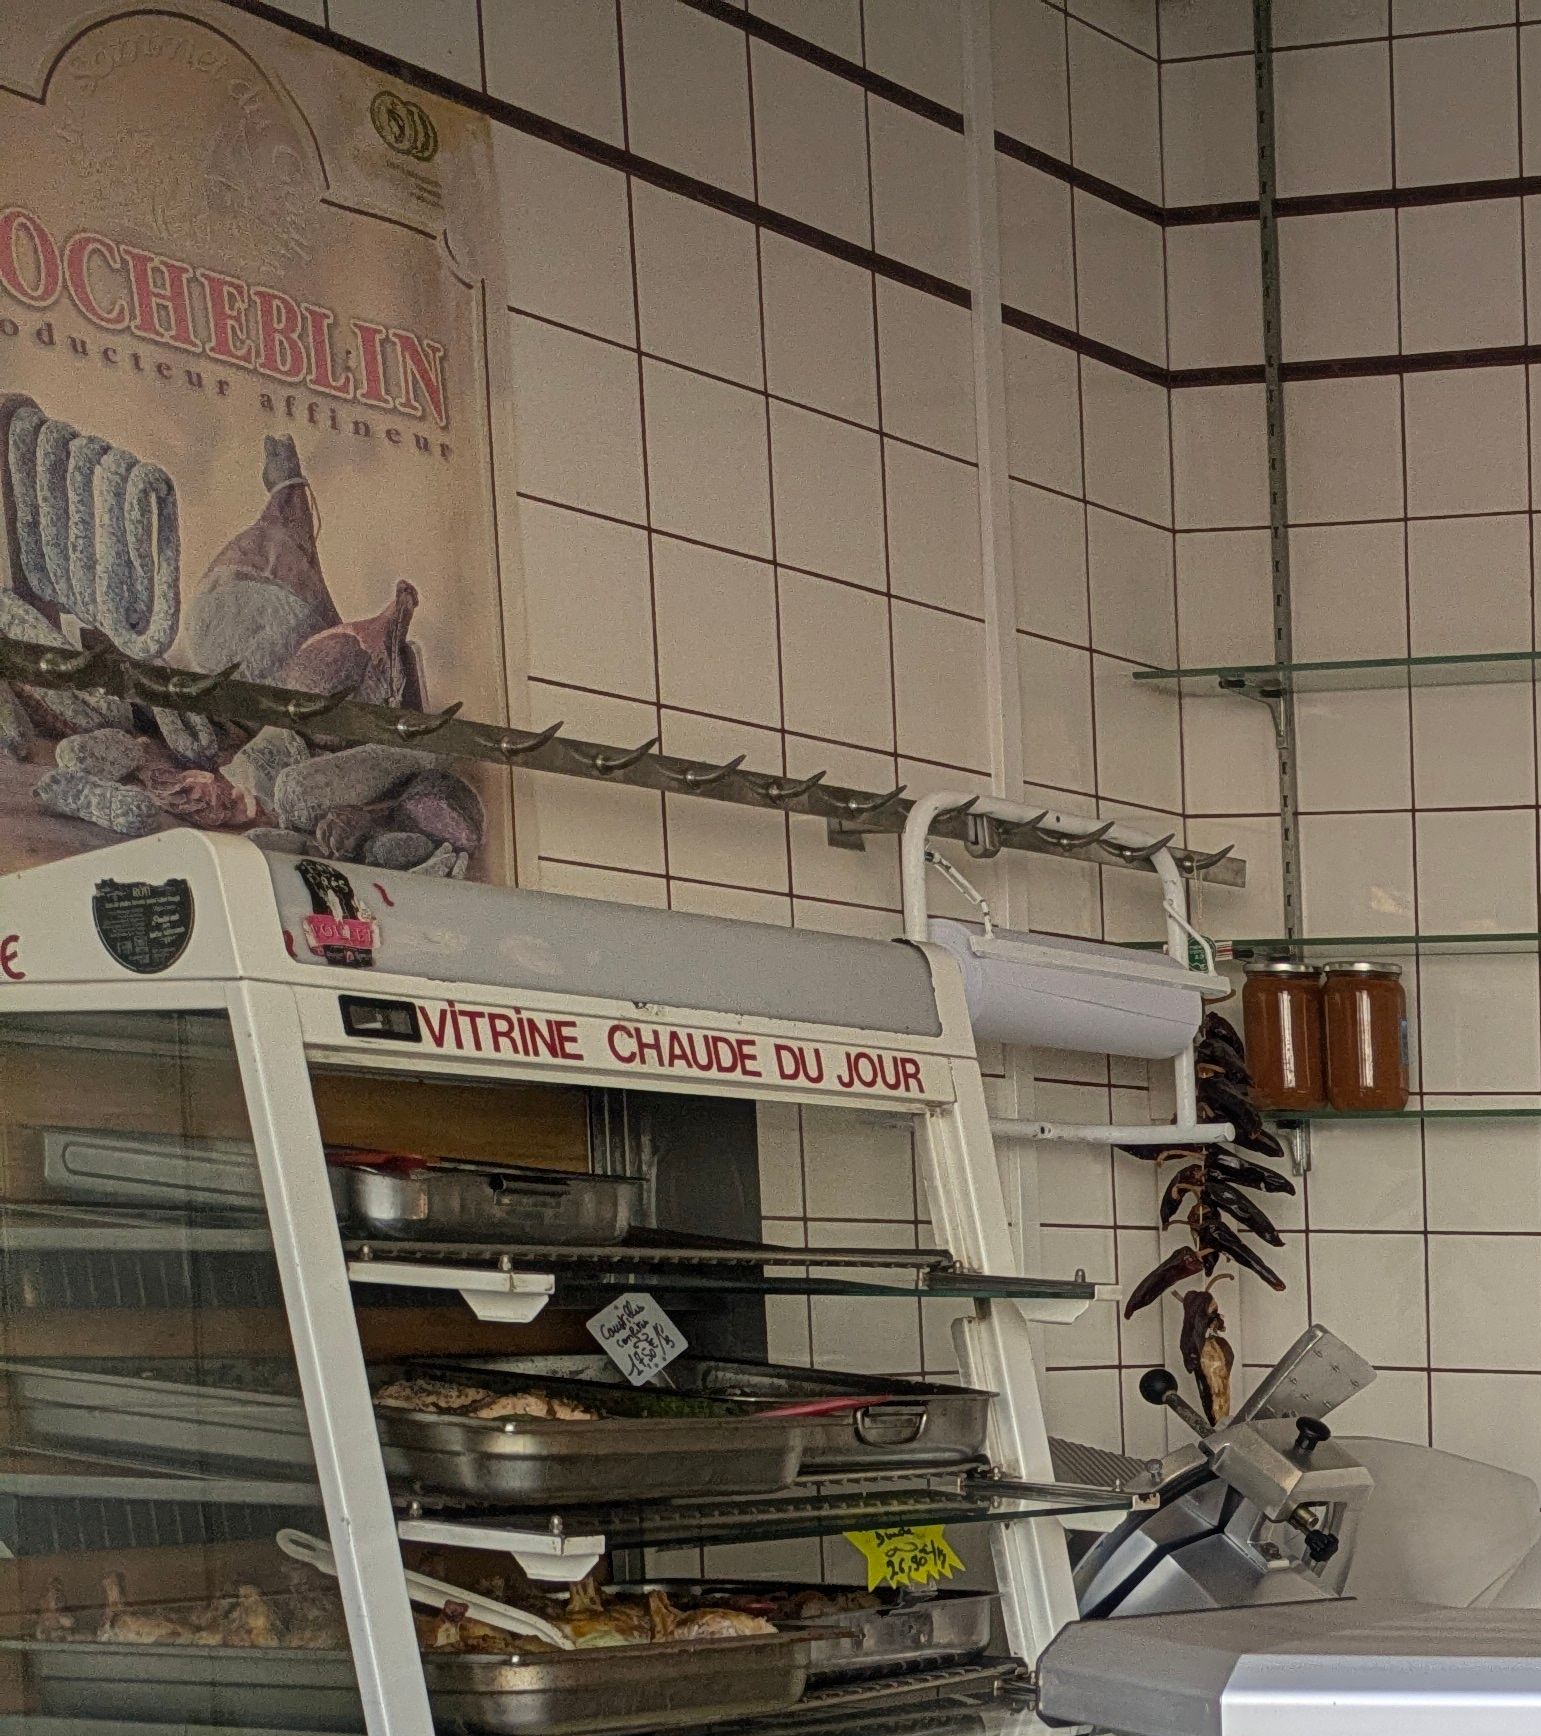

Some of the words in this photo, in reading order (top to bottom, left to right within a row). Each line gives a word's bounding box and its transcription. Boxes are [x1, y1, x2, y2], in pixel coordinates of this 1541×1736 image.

[0, 206, 447, 429] OCHEBLIN
[0, 316, 229, 397] oducteur
[259, 389, 454, 460] affineur
[606, 1023, 763, 1078] CHAUDE
[776, 1044, 824, 1084] DU
[836, 1052, 926, 1093] JOUR
